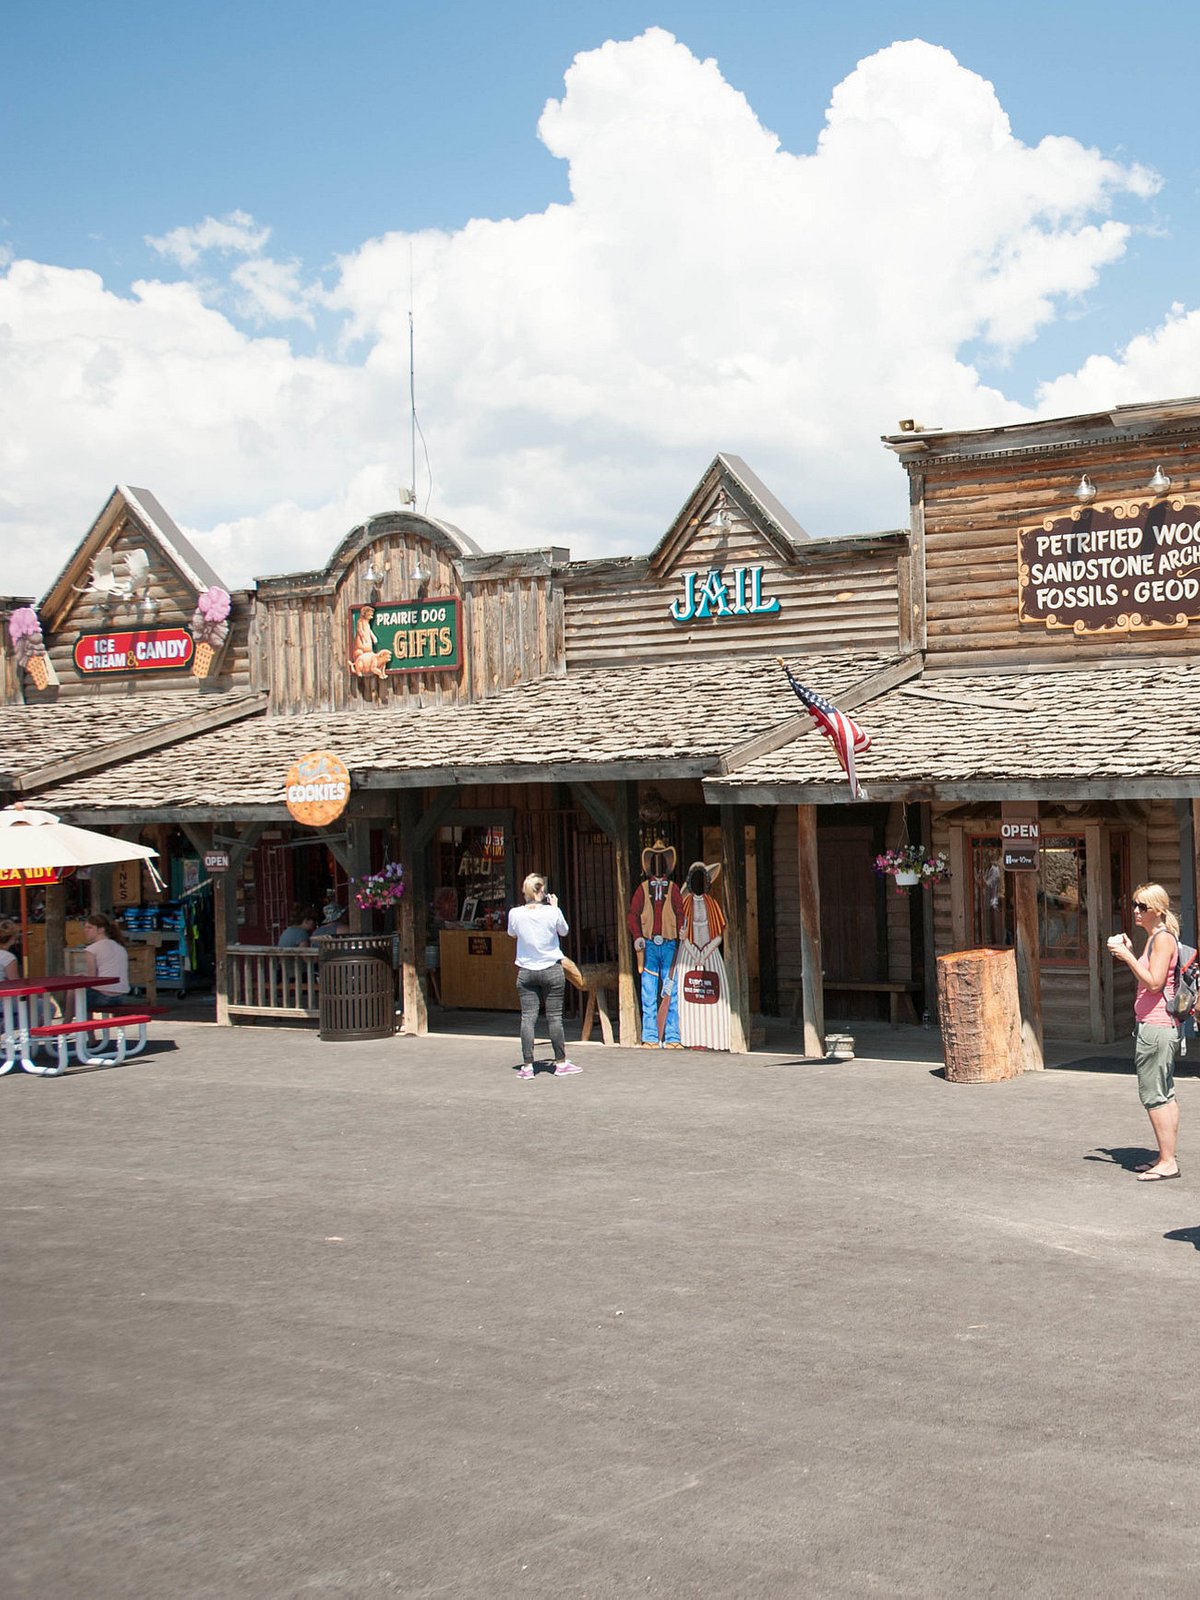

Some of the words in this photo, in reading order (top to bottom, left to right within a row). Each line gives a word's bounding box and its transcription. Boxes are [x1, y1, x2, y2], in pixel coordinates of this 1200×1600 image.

[1036, 527, 1143, 557] PETRIFIED
[1031, 553, 1155, 585] SANDSTONE
[669, 565, 781, 622] JAIL
[1036, 584, 1119, 610] FOSSILS
[376, 610, 419, 627] PRAIRIE
[421, 607, 447, 624] DOG
[84, 653, 127, 670] CREAM
[136, 639, 188, 661] CANDY
[94, 639, 116, 654] ICE
[393, 626, 453, 660] GIFTS
[288, 782, 346, 803] COOKIES
[1001, 824, 1039, 838] OPEN
[0, 866, 53, 880] CANDY
[205, 856, 229, 867] OPEN
[119, 863, 129, 899] INKS
